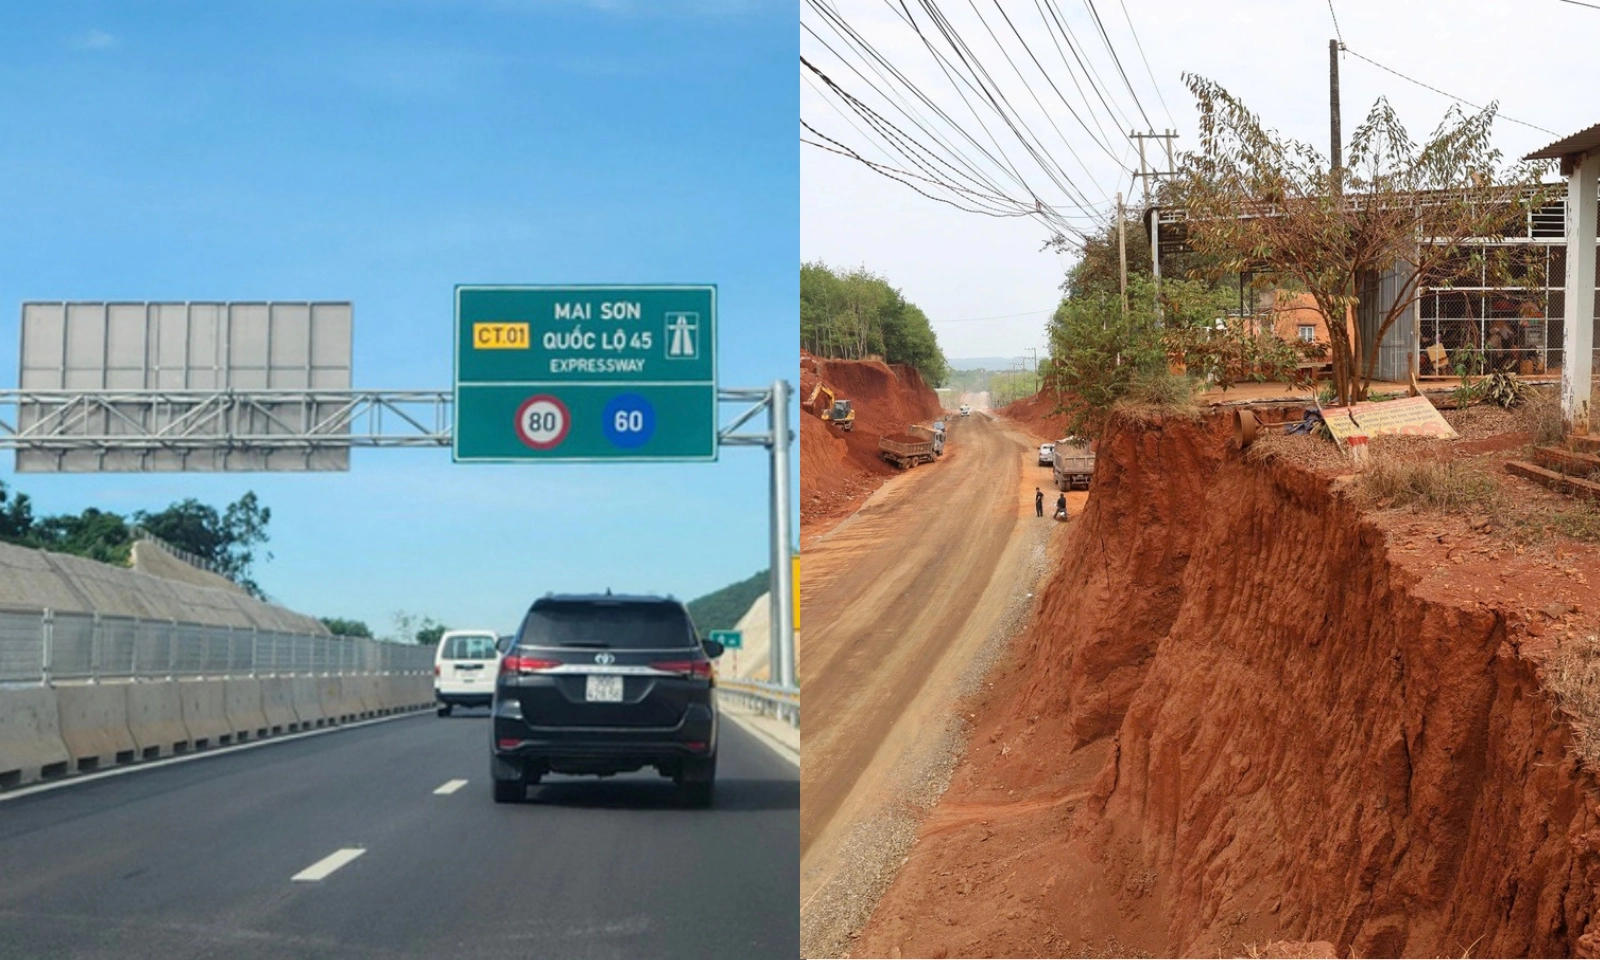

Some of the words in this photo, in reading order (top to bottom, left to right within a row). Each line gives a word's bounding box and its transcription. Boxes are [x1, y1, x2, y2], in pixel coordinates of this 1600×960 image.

[554, 302, 591, 320] MAI
[600, 301, 641, 320] SƠN
[478, 327, 525, 344] CT.01
[543, 324, 595, 350] QUỐC
[602, 332, 625, 353] LỘ
[630, 333, 652, 349] 45
[550, 359, 645, 372] EXPRESSWAY
[529, 413, 556, 432] 80
[614, 411, 643, 432] 60
